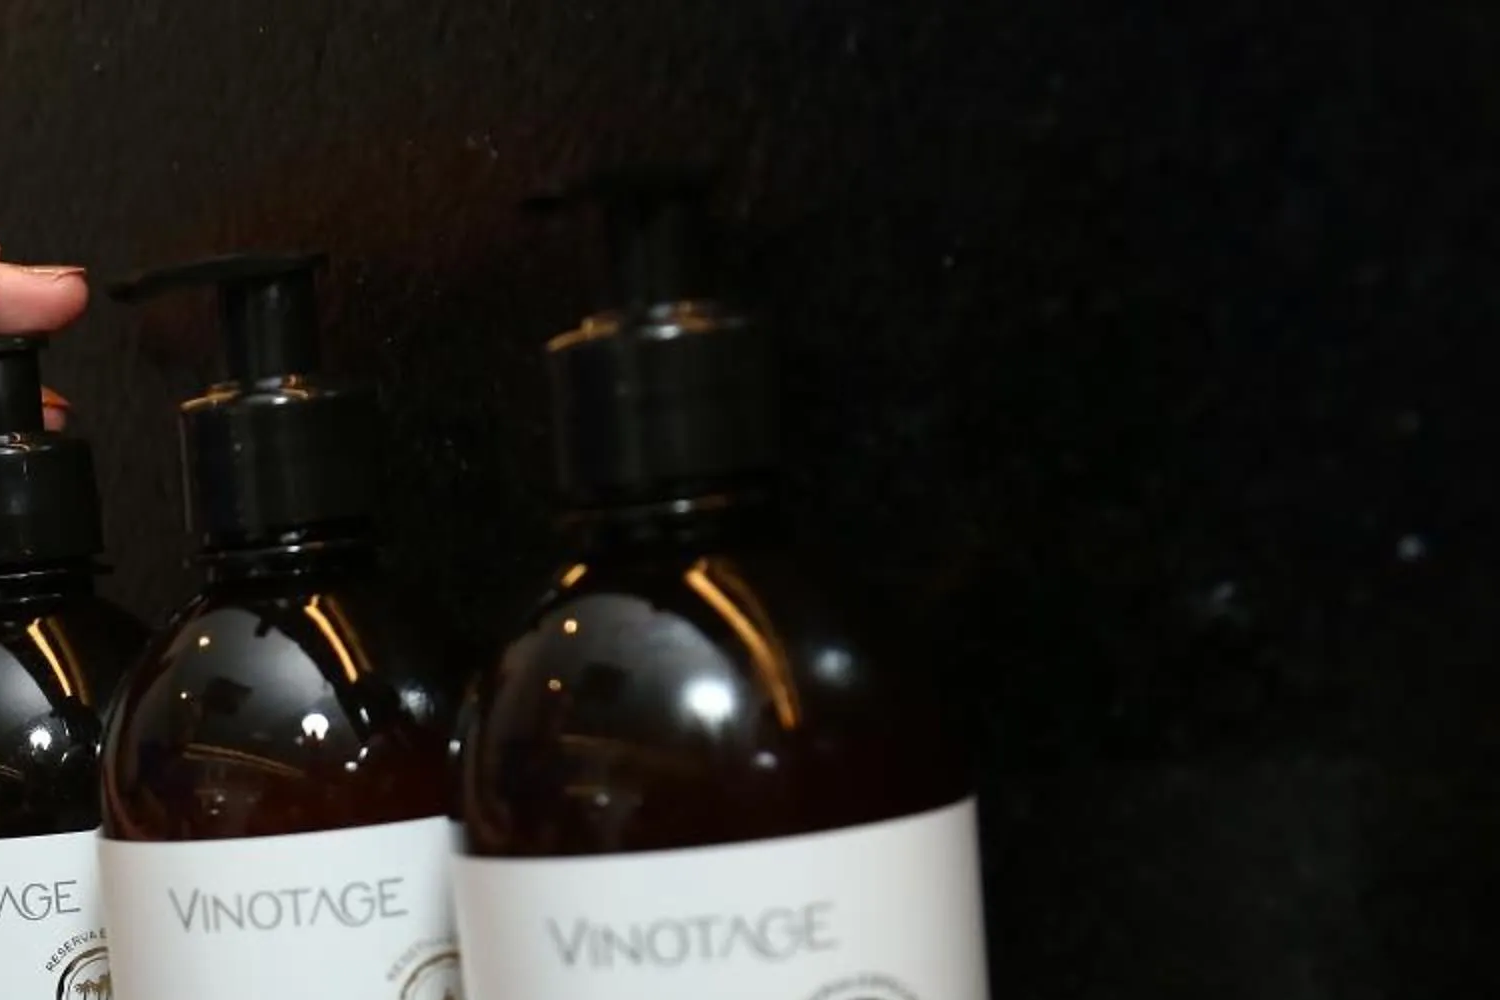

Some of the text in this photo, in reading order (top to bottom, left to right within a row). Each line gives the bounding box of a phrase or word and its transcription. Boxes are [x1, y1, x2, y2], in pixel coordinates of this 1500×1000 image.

[167, 877, 409, 935] VINOTAGE
[545, 900, 839, 968] VINOTAGE
[45, 930, 98, 972] RESERVA
